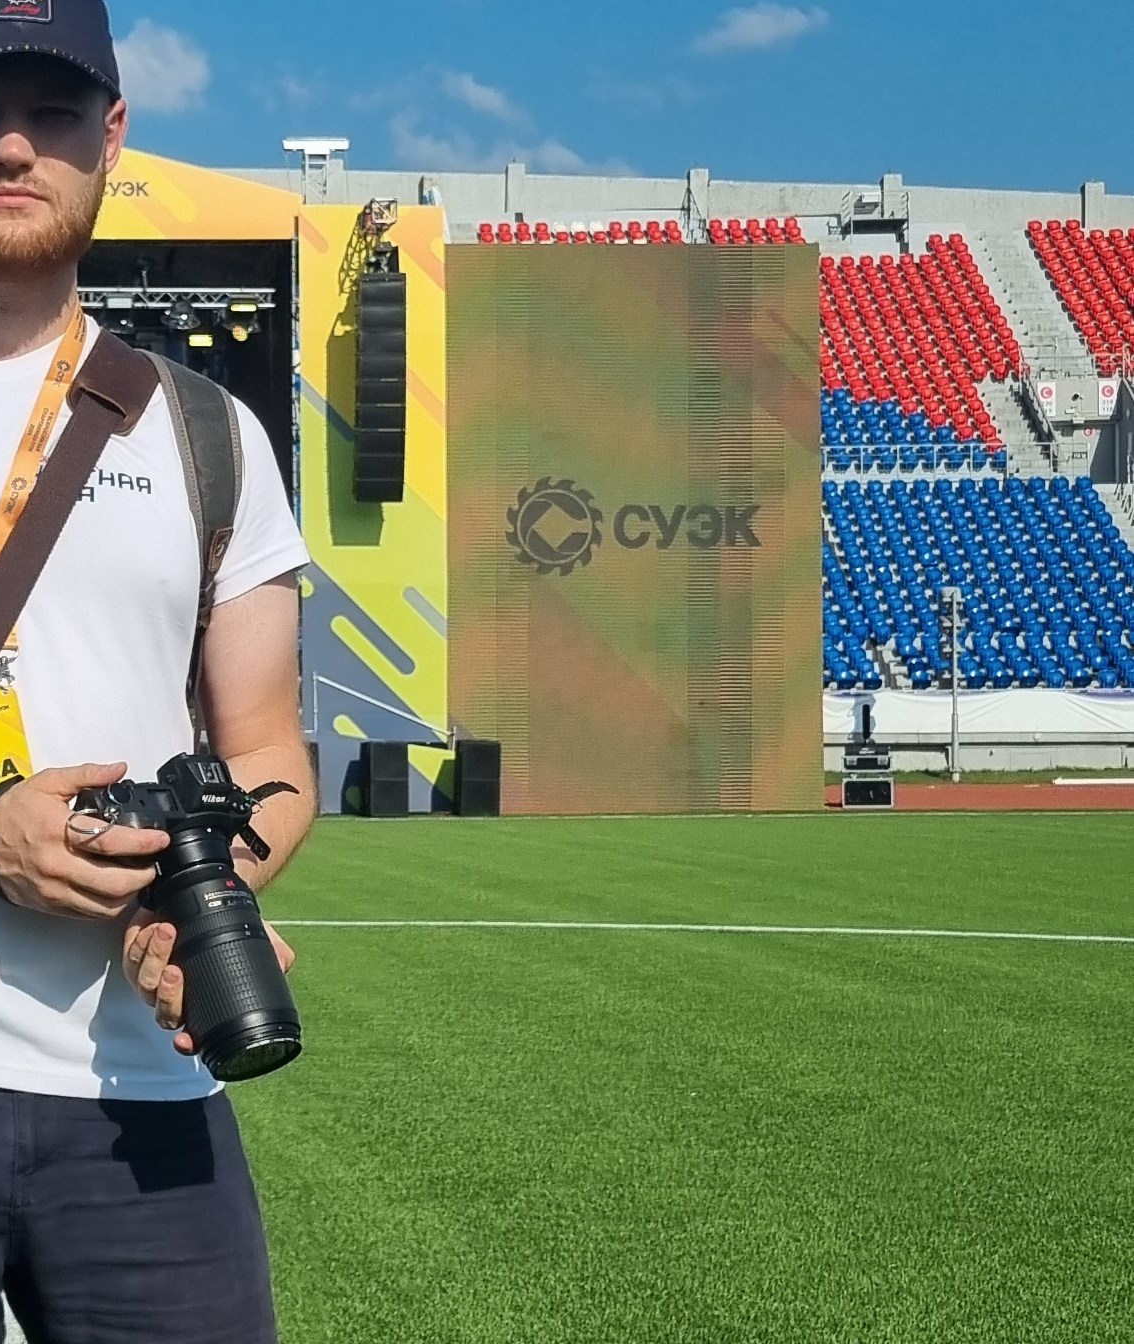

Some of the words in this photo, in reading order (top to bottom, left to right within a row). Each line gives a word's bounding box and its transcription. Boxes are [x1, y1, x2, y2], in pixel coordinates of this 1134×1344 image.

[104, 181, 149, 197] УЭК
[93, 465, 152, 495] НАЯ
[613, 504, 763, 550] СУЭК
